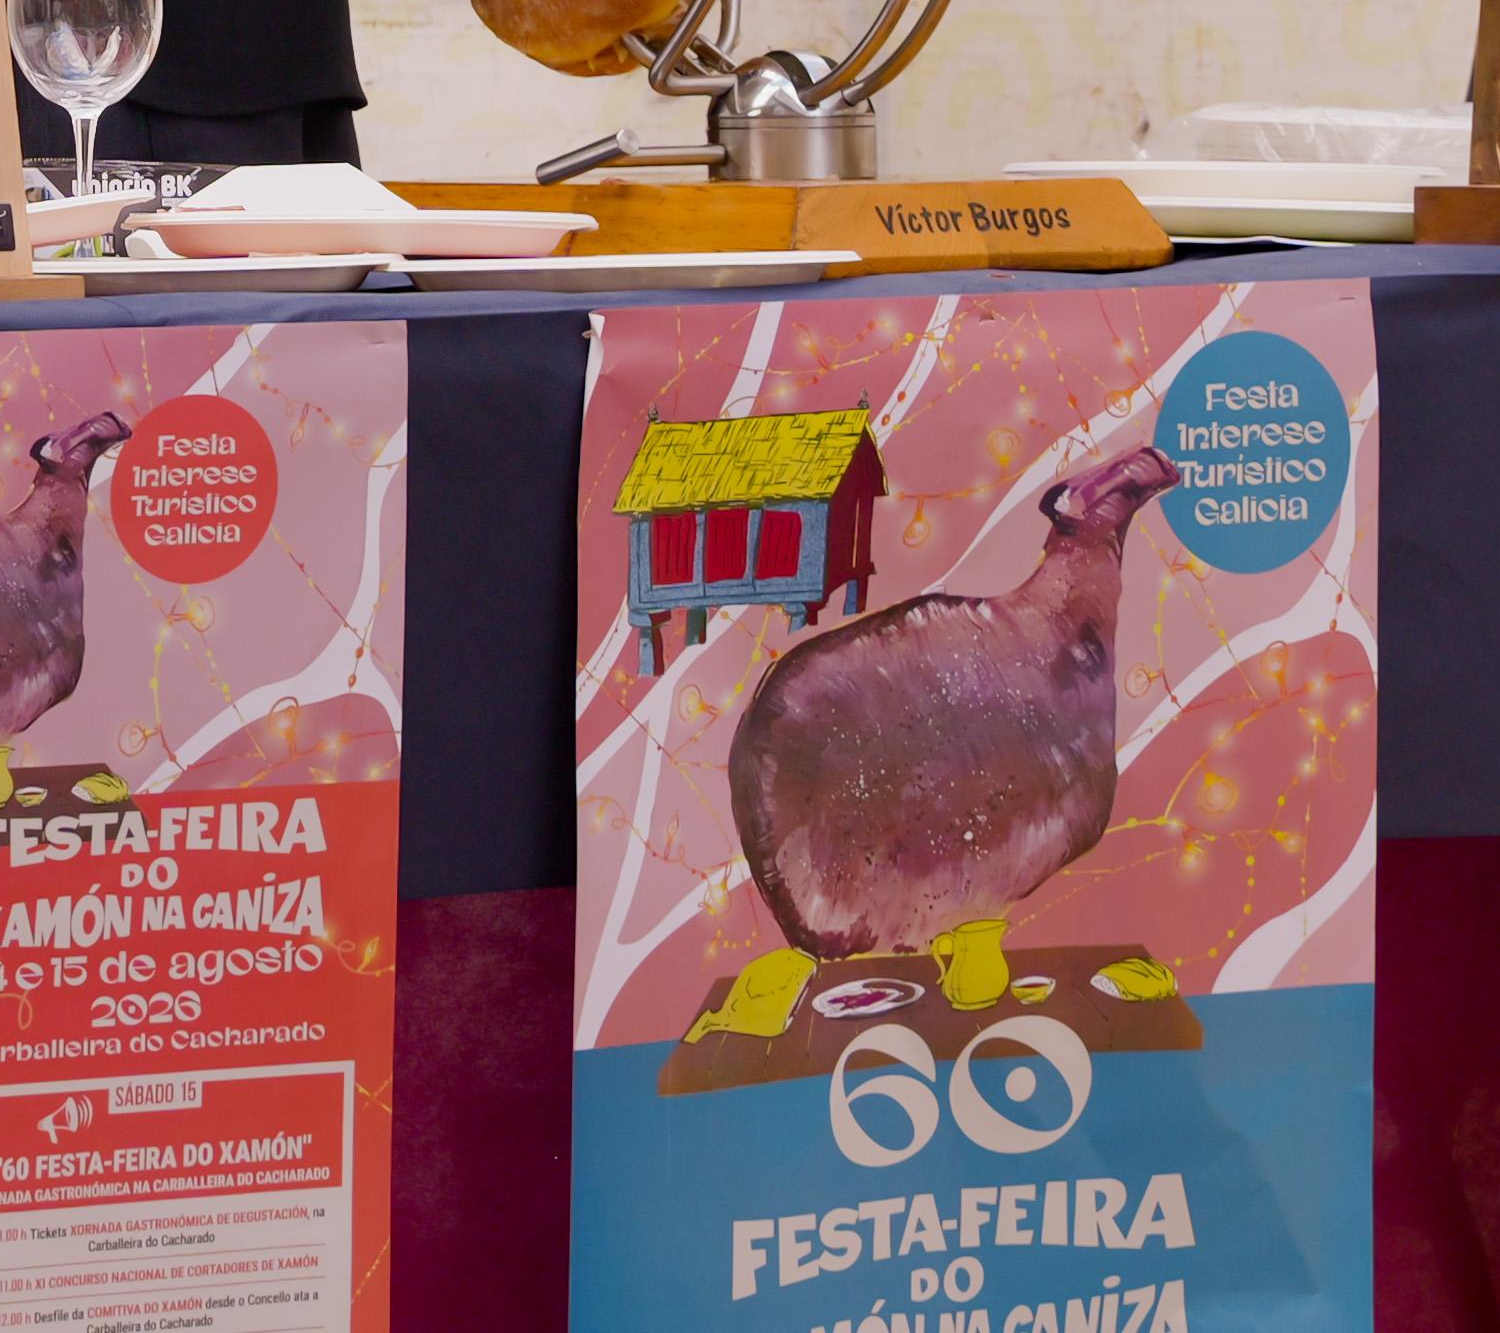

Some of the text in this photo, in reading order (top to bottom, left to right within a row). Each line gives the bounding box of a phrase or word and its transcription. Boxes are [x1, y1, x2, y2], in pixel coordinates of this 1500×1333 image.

[875, 202, 1071, 236] Víctor Burgos
[1205, 381, 1299, 411] Festa
[158, 433, 236, 457] Festa
[1177, 421, 1326, 451] Interese
[132, 465, 257, 487] Interese
[1175, 454, 1327, 488] Turístico
[131, 490, 257, 517] Turístico
[1194, 495, 1308, 526] Galicia
[144, 522, 241, 546] Galicia
[121, 856, 179, 890] DO
[142, 895, 186, 932] NA
[15, 962, 44, 990] e
[51, 955, 88, 988] 15
[99, 951, 157, 983] de
[168, 940, 324, 985] agosto
[91, 990, 202, 1028] 2026
[129, 1033, 164, 1054] do
[171, 1022, 326, 1048] Cacharado
[116, 1081, 196, 1107] SÁBADO 15
[828, 1014, 1094, 1168] 60
[36, 1145, 177, 1179] FESTA-FEIRA
[183, 1142, 213, 1167] DO
[219, 1131, 312, 1165] XAMÓN"
[35, 1181, 130, 1202] GASTRONÓMICA
[133, 1180, 151, 1193] NA
[154, 1172, 235, 1192] CARBALLEIRA
[237, 1172, 253, 1186] DO
[256, 1167, 330, 1184] CACHARADO
[731, 1172, 1196, 1301] FESTA-FEIRA
[910, 1256, 985, 1303] DO
